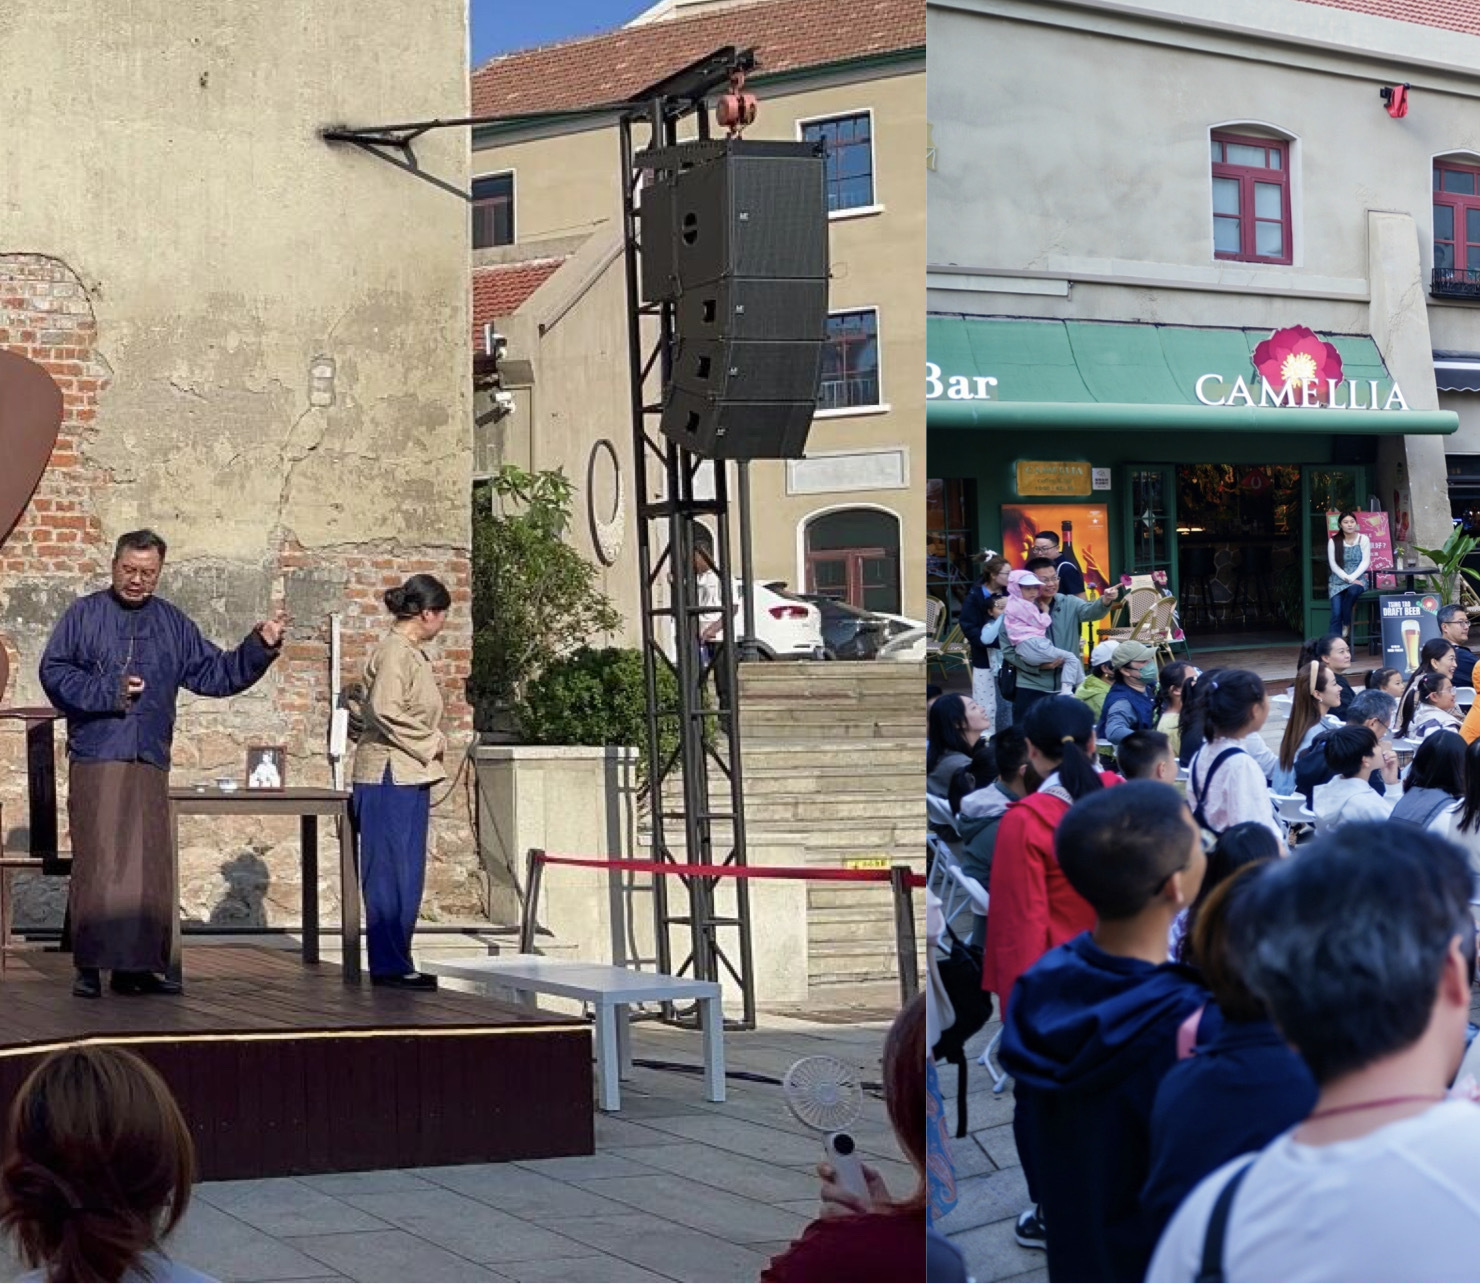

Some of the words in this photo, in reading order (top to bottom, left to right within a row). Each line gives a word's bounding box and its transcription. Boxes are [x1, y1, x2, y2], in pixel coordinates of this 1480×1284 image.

[926, 361, 998, 400] Bar
[1195, 373, 1409, 411] CAMELLIA
[1383, 607, 1403, 616] DRAFT
[1404, 606, 1421, 615] BEER
